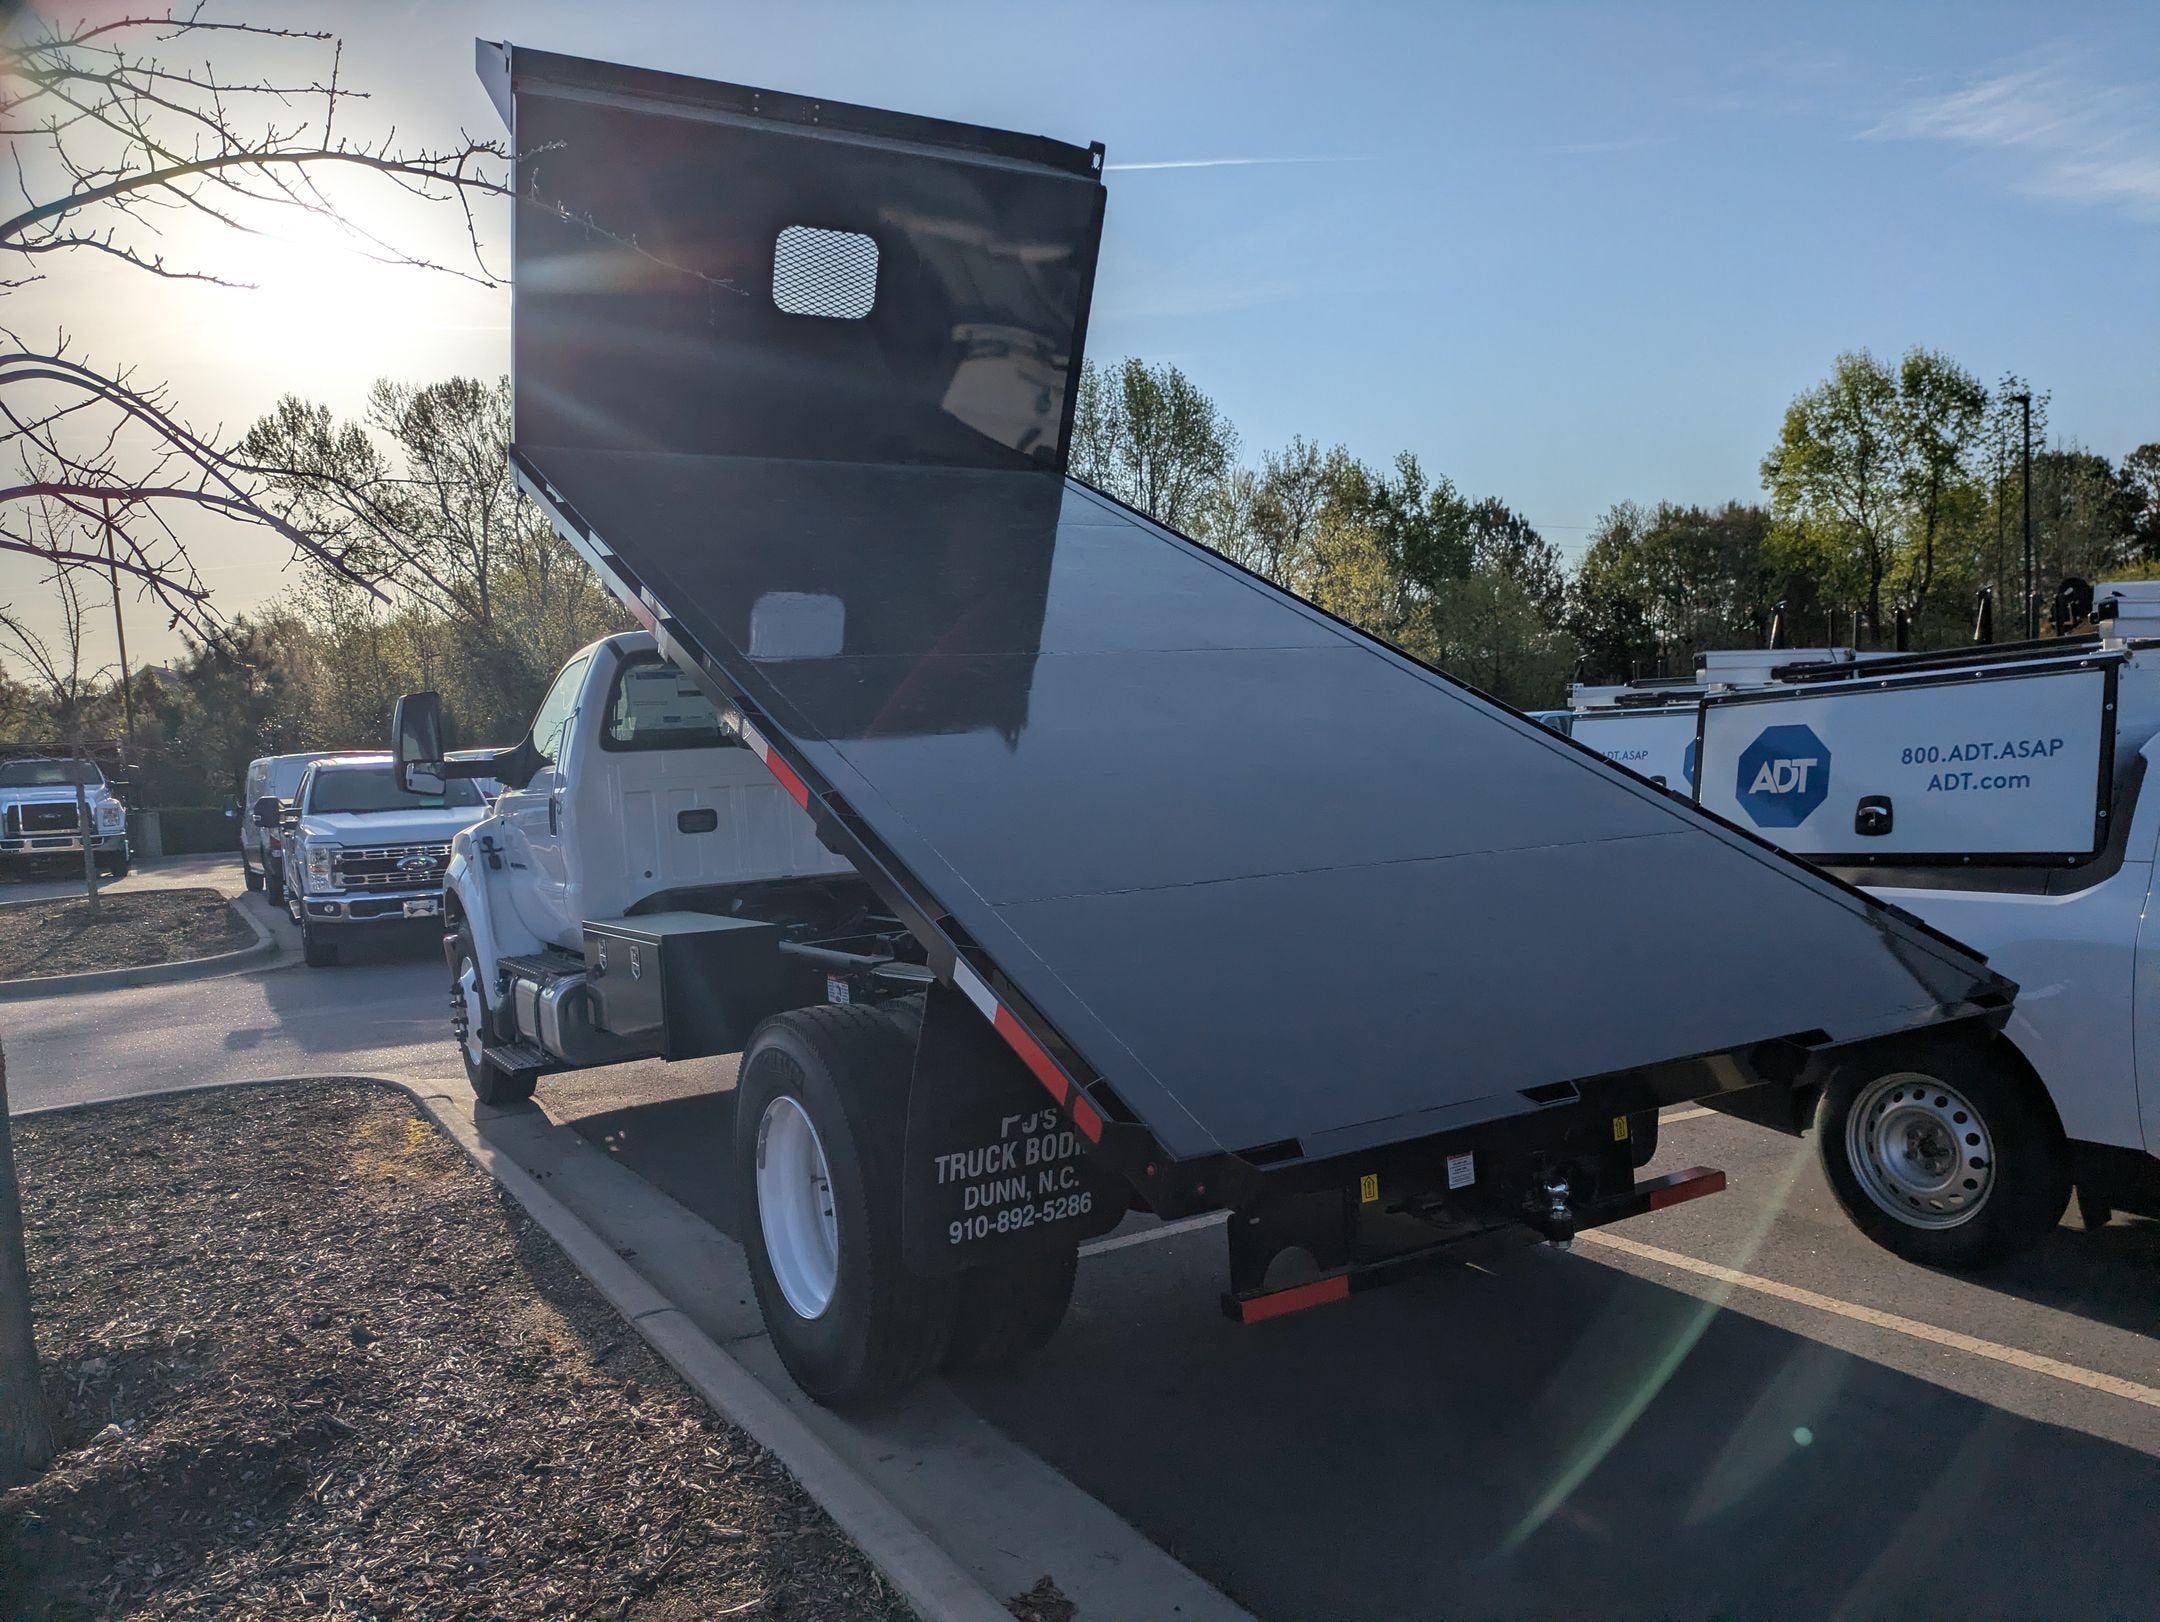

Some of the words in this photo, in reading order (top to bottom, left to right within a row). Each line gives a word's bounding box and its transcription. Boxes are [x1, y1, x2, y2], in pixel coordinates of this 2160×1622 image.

[1901, 738, 2064, 765] 800.ADT.ASAP
[1748, 758, 1818, 794] ADT
[1927, 772, 2031, 792] ADT.com
[934, 1141, 1019, 1184] TRUCK
[964, 1175, 1032, 1211] DUNN,
[1038, 1166, 1080, 1195] N.C.
[949, 1192, 1093, 1244] 910-892-5286
